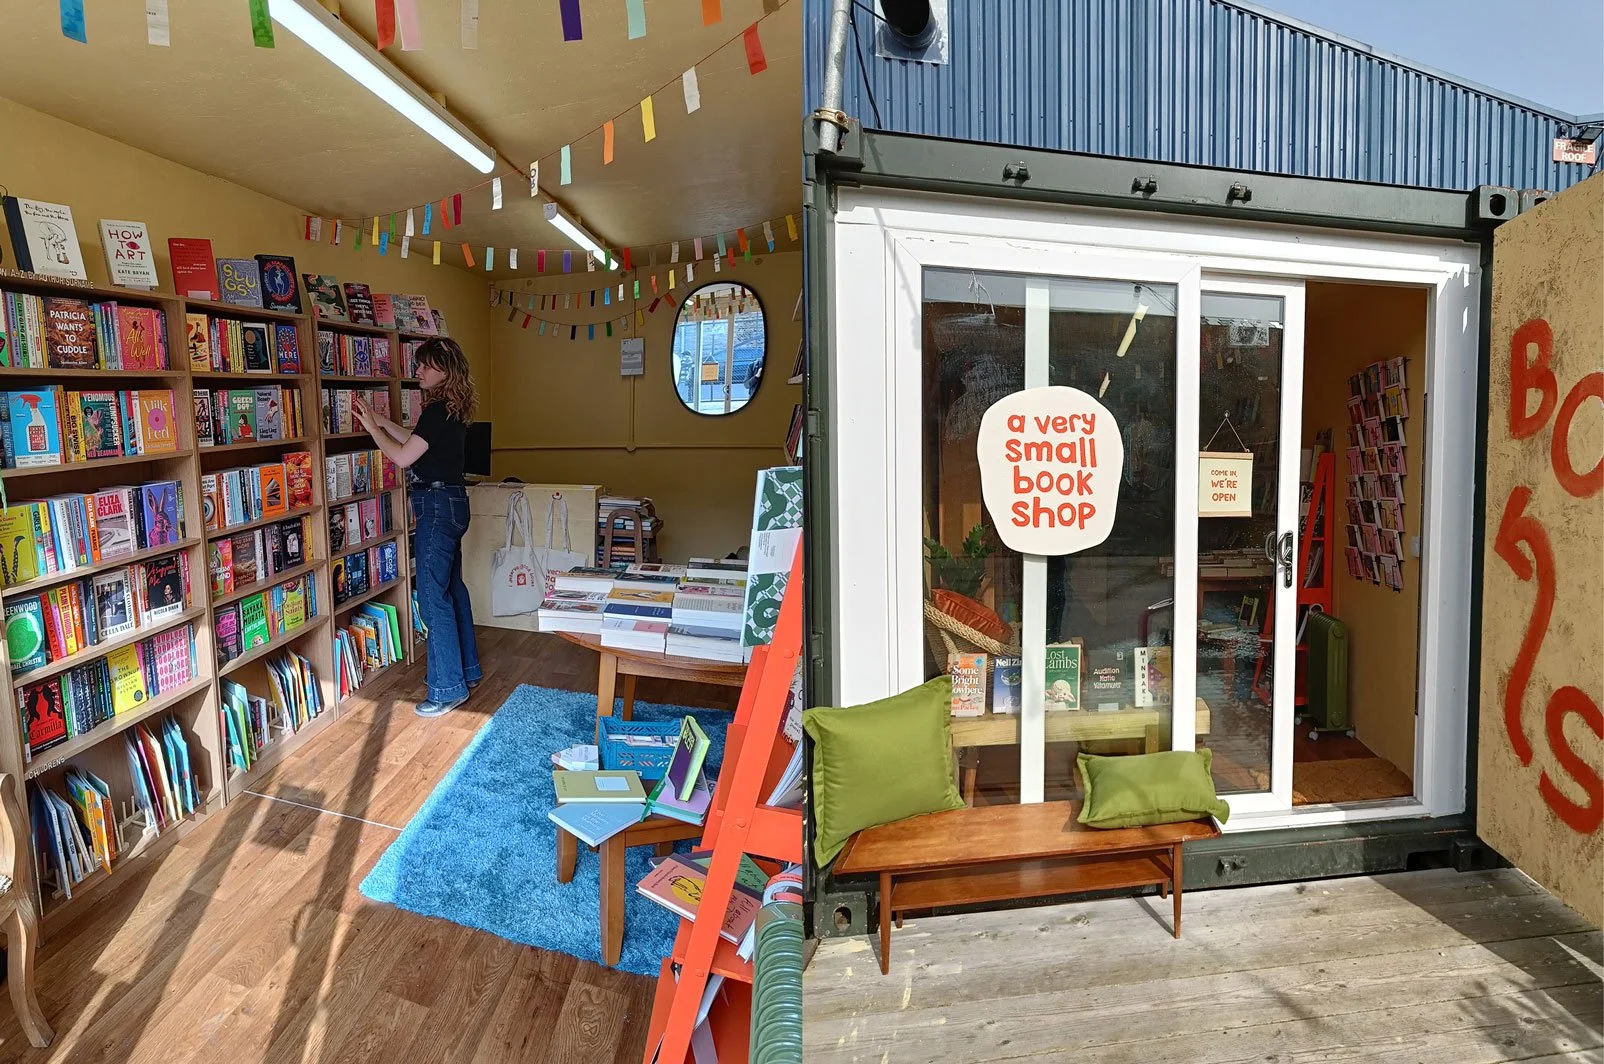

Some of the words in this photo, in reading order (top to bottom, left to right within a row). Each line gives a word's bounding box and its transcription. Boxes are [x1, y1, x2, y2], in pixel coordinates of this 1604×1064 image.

[1556, 142, 1593, 152] FRAGILE
[1562, 152, 1586, 161] ROOF
[108, 230, 143, 239] HOW
[115, 250, 146, 260] ART
[50, 310, 86, 320] PATRICIA
[56, 322, 83, 331] WANTS
[126, 329, 144, 344] All's
[57, 346, 88, 354] CUDDLE
[130, 345, 152, 357] Well
[83, 392, 115, 402] VENOMOUS
[144, 400, 168, 412] Milk
[109, 402, 118, 446] LUMPSUCKER
[1007, 414, 1025, 433] a
[1034, 413, 1096, 435] very
[1005, 437, 1097, 468] small
[1013, 465, 1093, 496] book
[1211, 478, 1238, 488] WE'RE
[98, 496, 120, 506] ELIZA
[1212, 493, 1236, 501] OPEN
[97, 503, 123, 517] CLARK
[1011, 496, 1096, 530] shop
[33, 511, 41, 532] GIRLS
[4, 602, 38, 615] EENWOOD
[43, 594, 51, 617] DARK
[243, 602, 263, 617] SAYAKA
[244, 610, 265, 625] MURATA
[64, 612, 73, 639] HEROINES
[101, 627, 120, 637] CELIA
[120, 623, 134, 633] DALE
[22, 657, 42, 668] CHRISTIE
[996, 658, 1011, 667] Nell
[1046, 657, 1077, 669] ambs
[110, 667, 140, 684] GROWNUP
[953, 666, 979, 674] Some
[117, 679, 138, 689] GILLIAN
[952, 675, 979, 686] Bright
[952, 686, 983, 694] owhere
[30, 722, 62, 740] Carmilla
[28, 756, 66, 779] CHILDRENS
